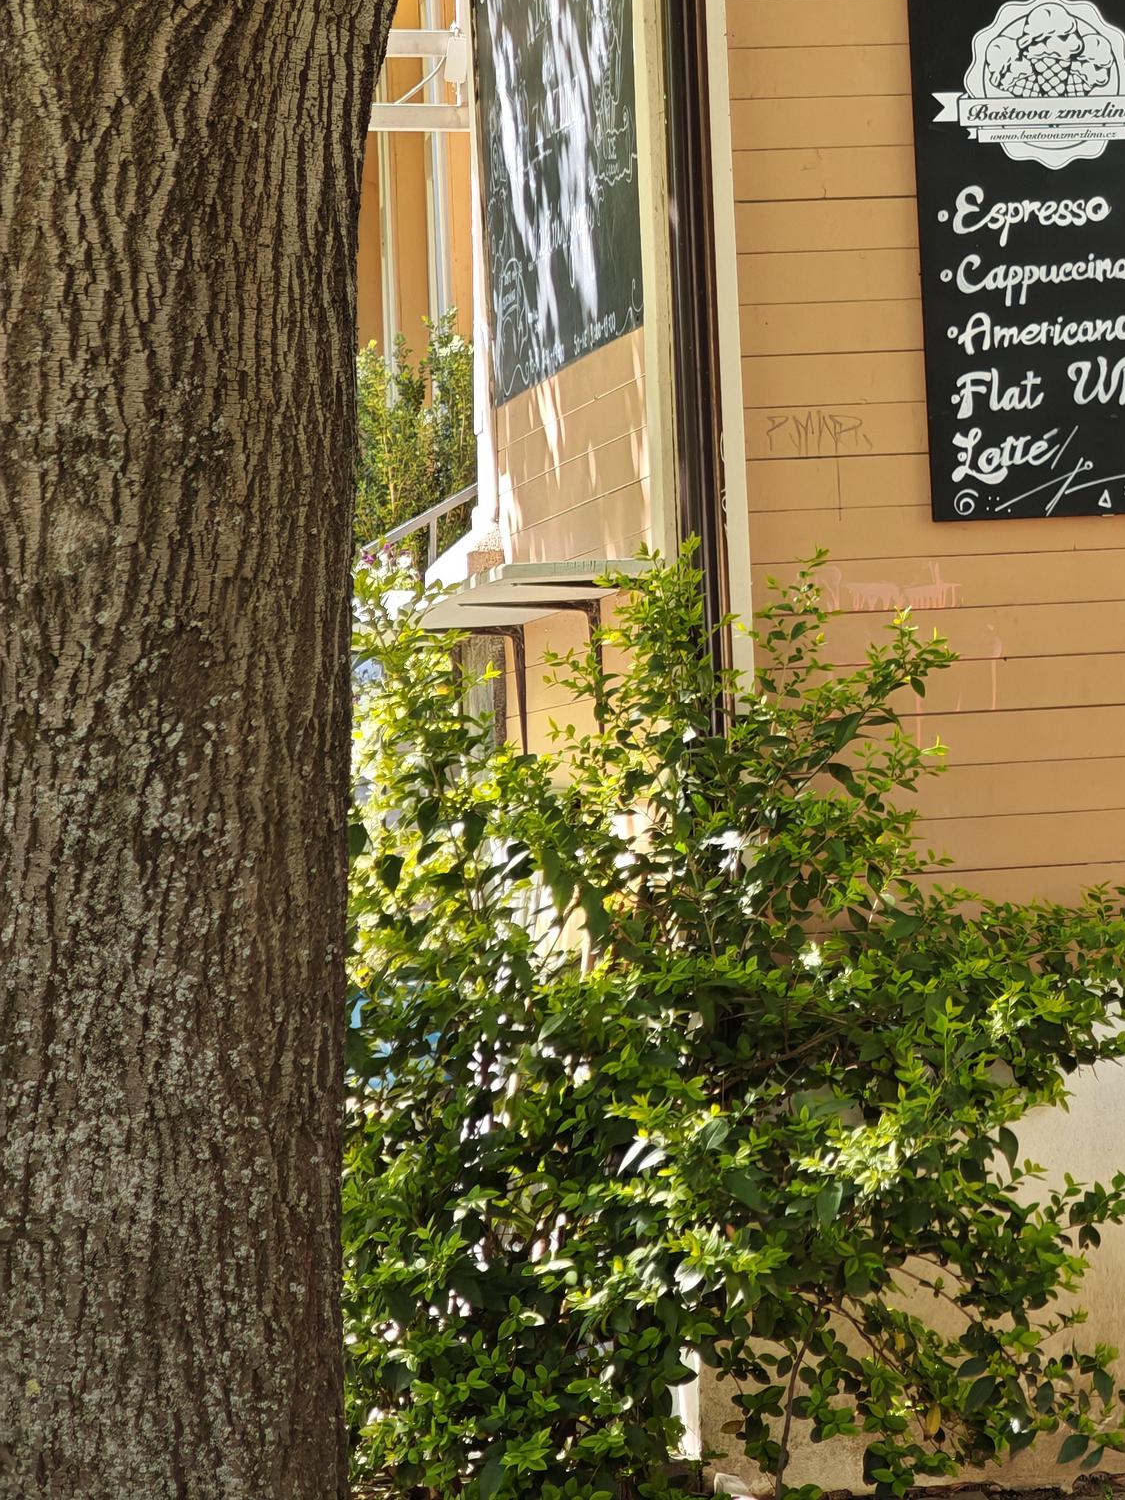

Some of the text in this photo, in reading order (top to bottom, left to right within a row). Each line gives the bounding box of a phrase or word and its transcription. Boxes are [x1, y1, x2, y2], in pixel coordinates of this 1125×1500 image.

[967, 102, 1051, 122] Baštova
[953, 186, 1112, 247] Espresso
[956, 367, 1045, 419] Flat
